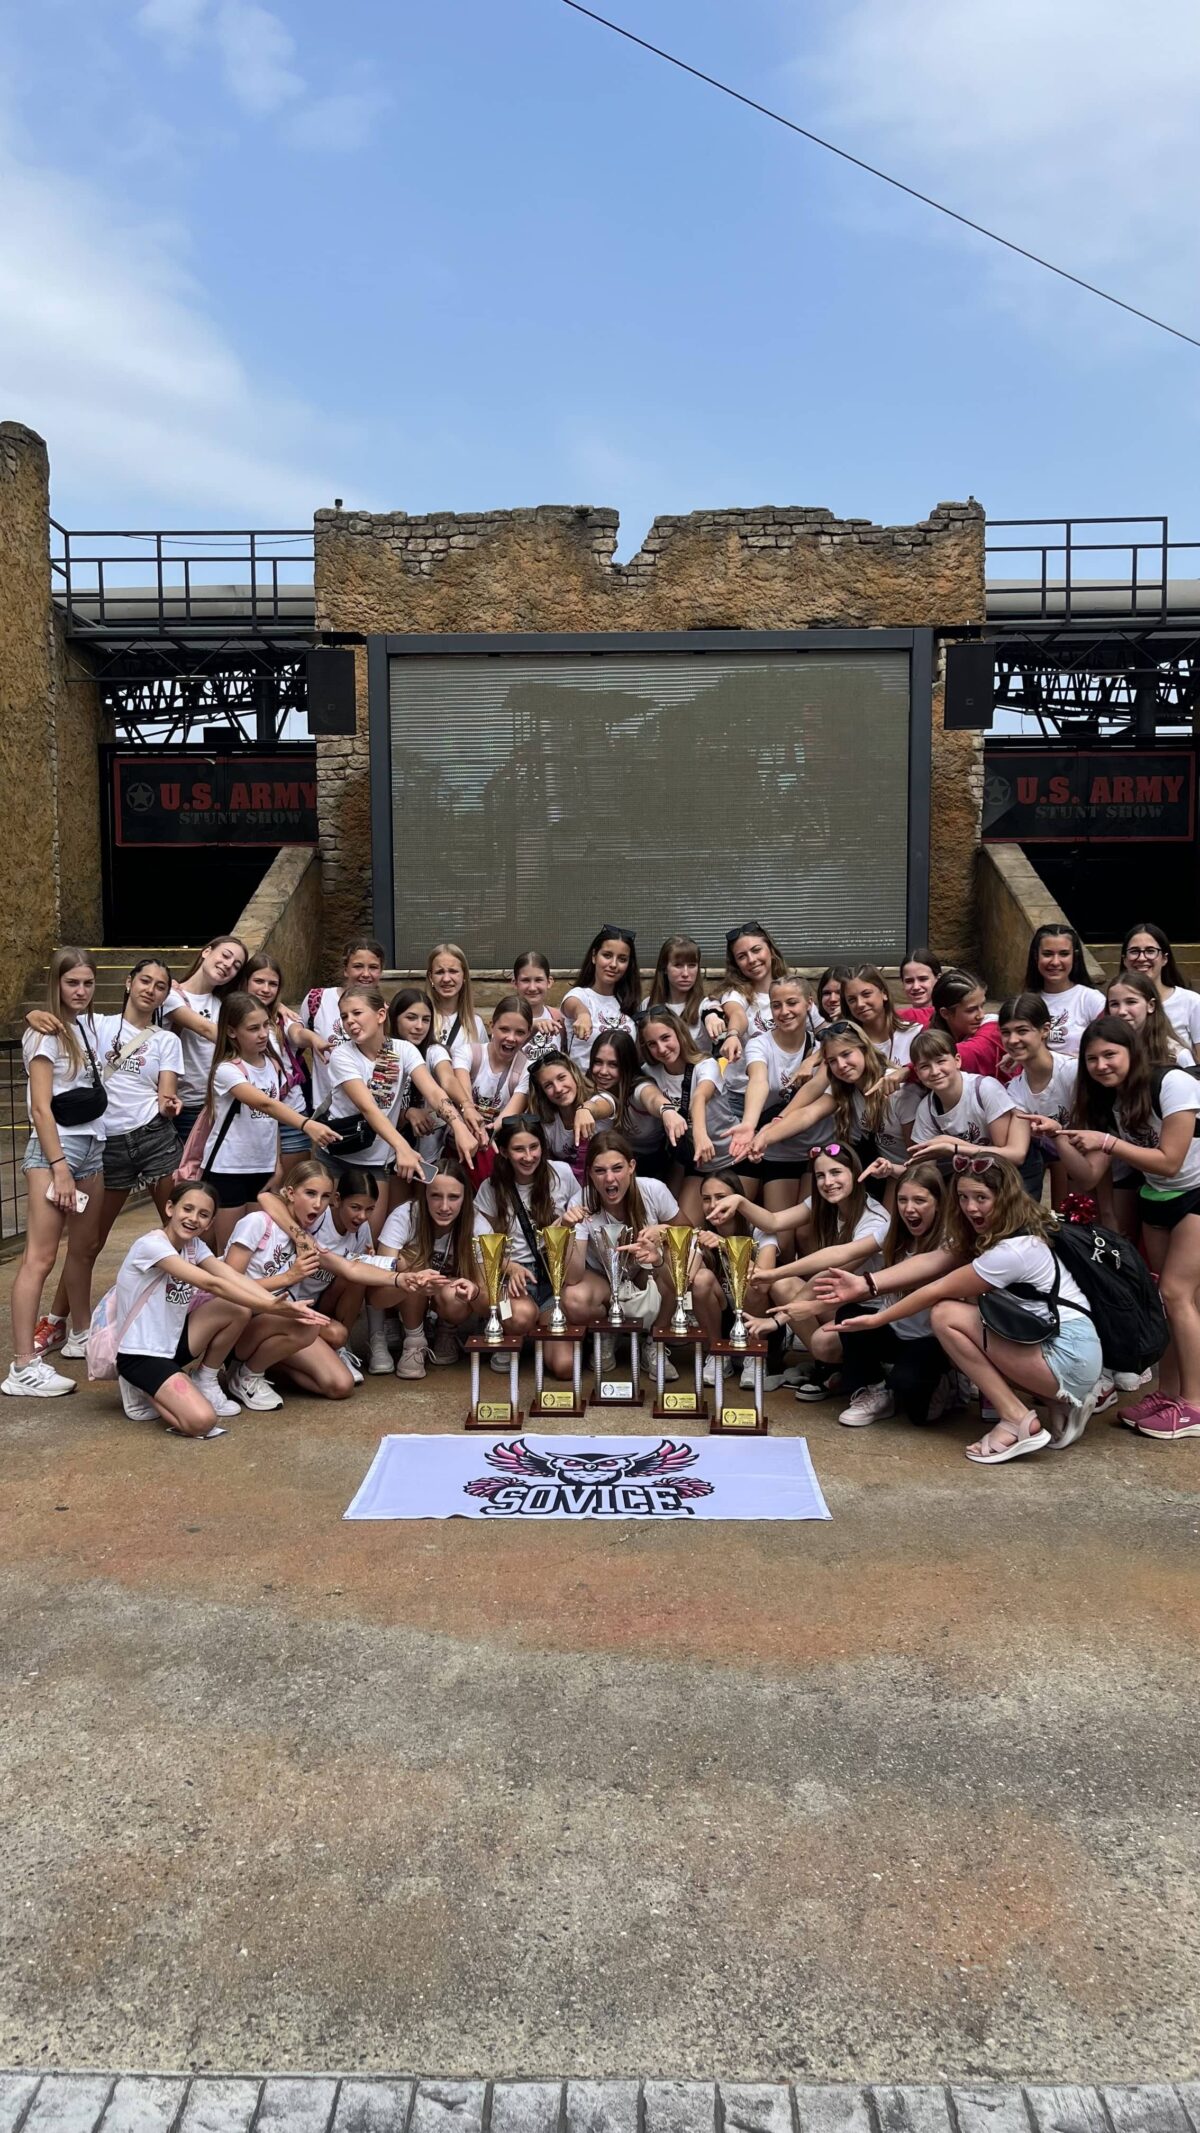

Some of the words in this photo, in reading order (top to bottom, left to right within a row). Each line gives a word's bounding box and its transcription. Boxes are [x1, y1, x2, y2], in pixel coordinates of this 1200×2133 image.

[160, 783, 221, 810] U.S.
[229, 782, 317, 809] ARMY
[1017, 777, 1080, 804] U.S.
[1089, 776, 1185, 803] ARMY
[179, 811, 240, 825] STUNT
[246, 811, 301, 825] SHOW
[1035, 805, 1100, 819] STUNT
[1106, 805, 1164, 818] SHOW
[479, 1484, 695, 1515] SOVICE
